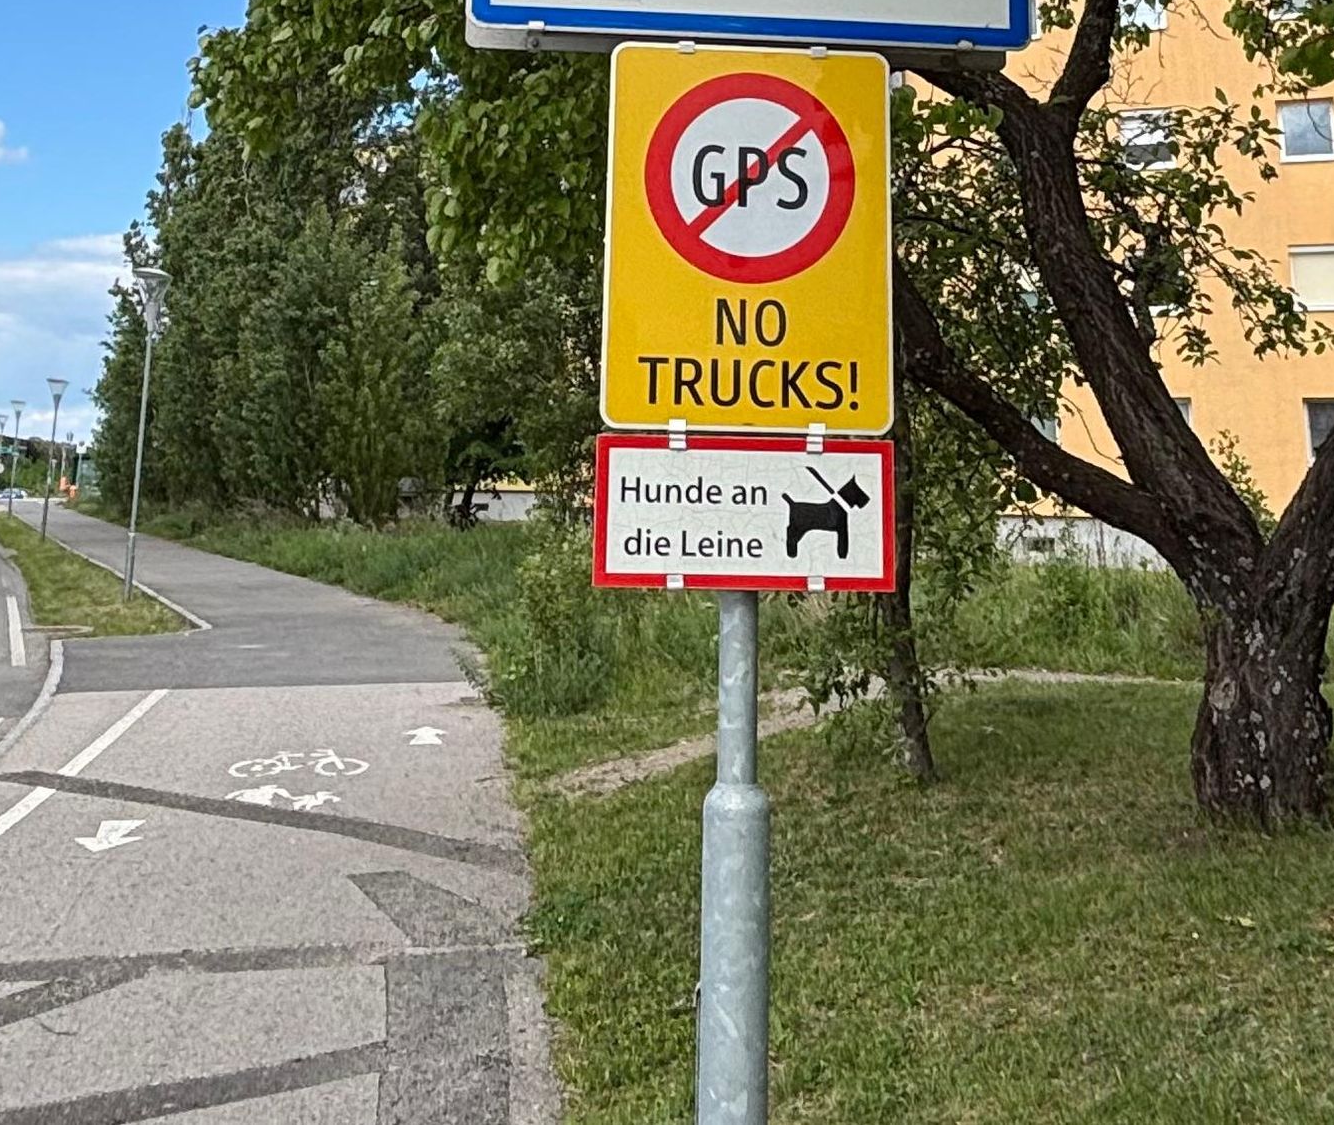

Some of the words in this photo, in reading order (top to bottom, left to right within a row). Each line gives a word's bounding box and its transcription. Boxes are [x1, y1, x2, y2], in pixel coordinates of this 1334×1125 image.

[692, 144, 809, 211] GPS
[715, 298, 787, 348] NO
[637, 356, 859, 411] TRUCKS!
[620, 476, 723, 505] Hunde
[731, 481, 768, 506] an
[623, 528, 671, 558] die
[681, 529, 764, 559] Leine
